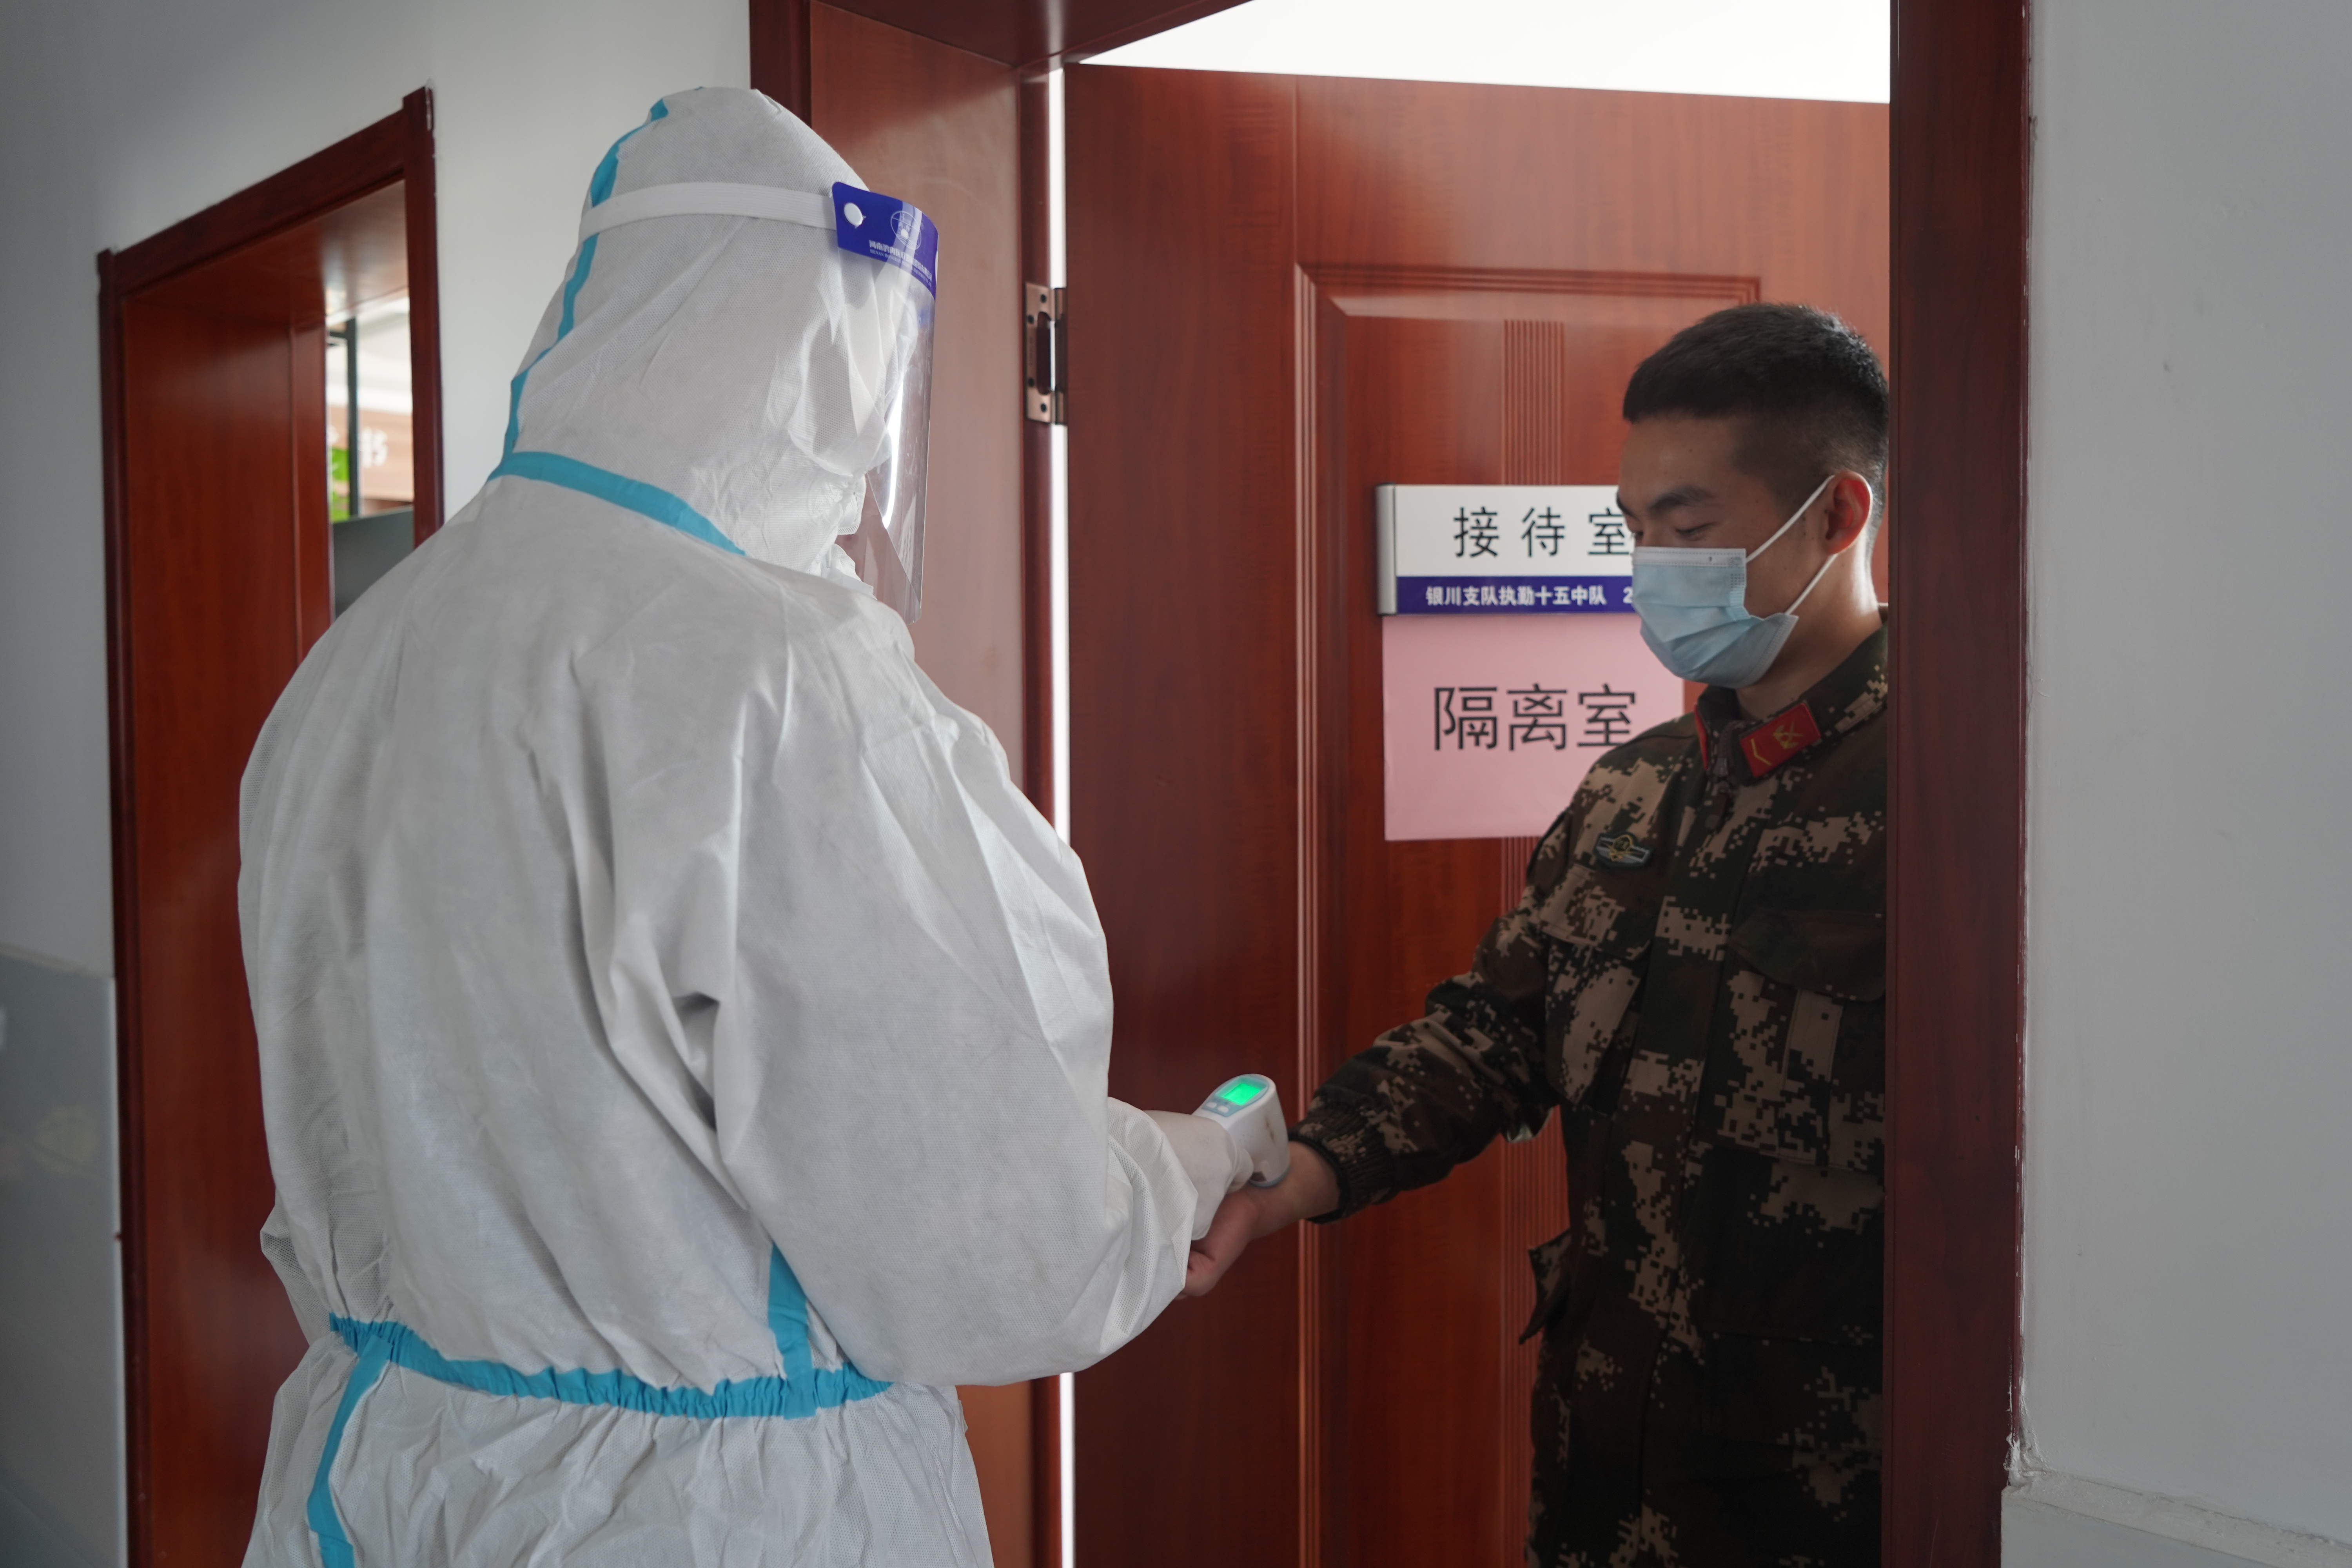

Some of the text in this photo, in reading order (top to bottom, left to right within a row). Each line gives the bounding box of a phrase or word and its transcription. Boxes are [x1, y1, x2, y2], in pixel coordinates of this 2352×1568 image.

[1453, 506, 1630, 559] 接待室
[1426, 586, 1607, 606] 银川支队执勤十五中队
[1434, 682, 1637, 752] 隔离室
